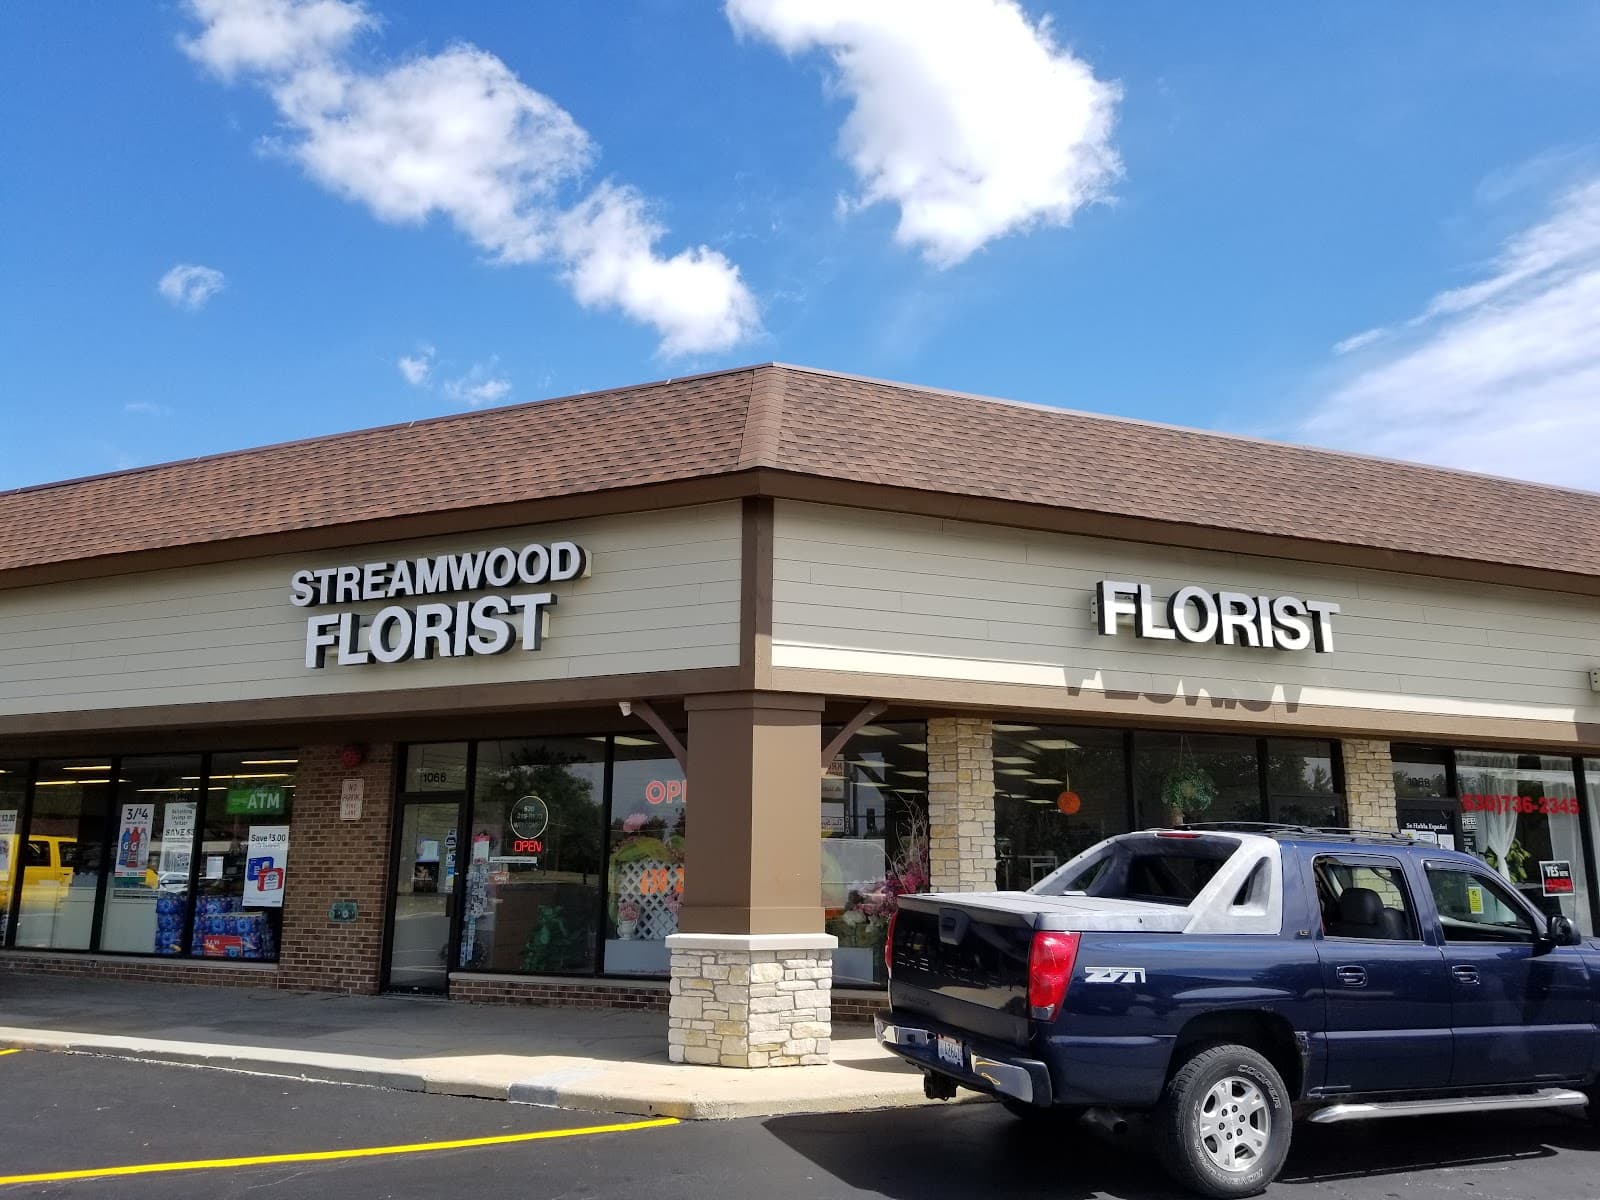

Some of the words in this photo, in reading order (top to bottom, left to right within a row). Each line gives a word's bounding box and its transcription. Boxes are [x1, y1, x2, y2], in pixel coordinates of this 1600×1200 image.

[289, 541, 584, 607] STREAMWOOD
[1098, 580, 1340, 653] FLORIST
[305, 592, 553, 668] FLORIST
[424, 773, 447, 783] 1066
[247, 792, 280, 809] ATM
[645, 780, 687, 805] OP
[1413, 822, 1428, 830] Habla
[250, 834, 267, 842] Save
[269, 833, 286, 842] $3.00
[514, 840, 542, 852] OPEN
[1545, 865, 1559, 877] YES
[1085, 967, 1146, 983] Z71
[1238, 1064, 1281, 1109] COOPER
